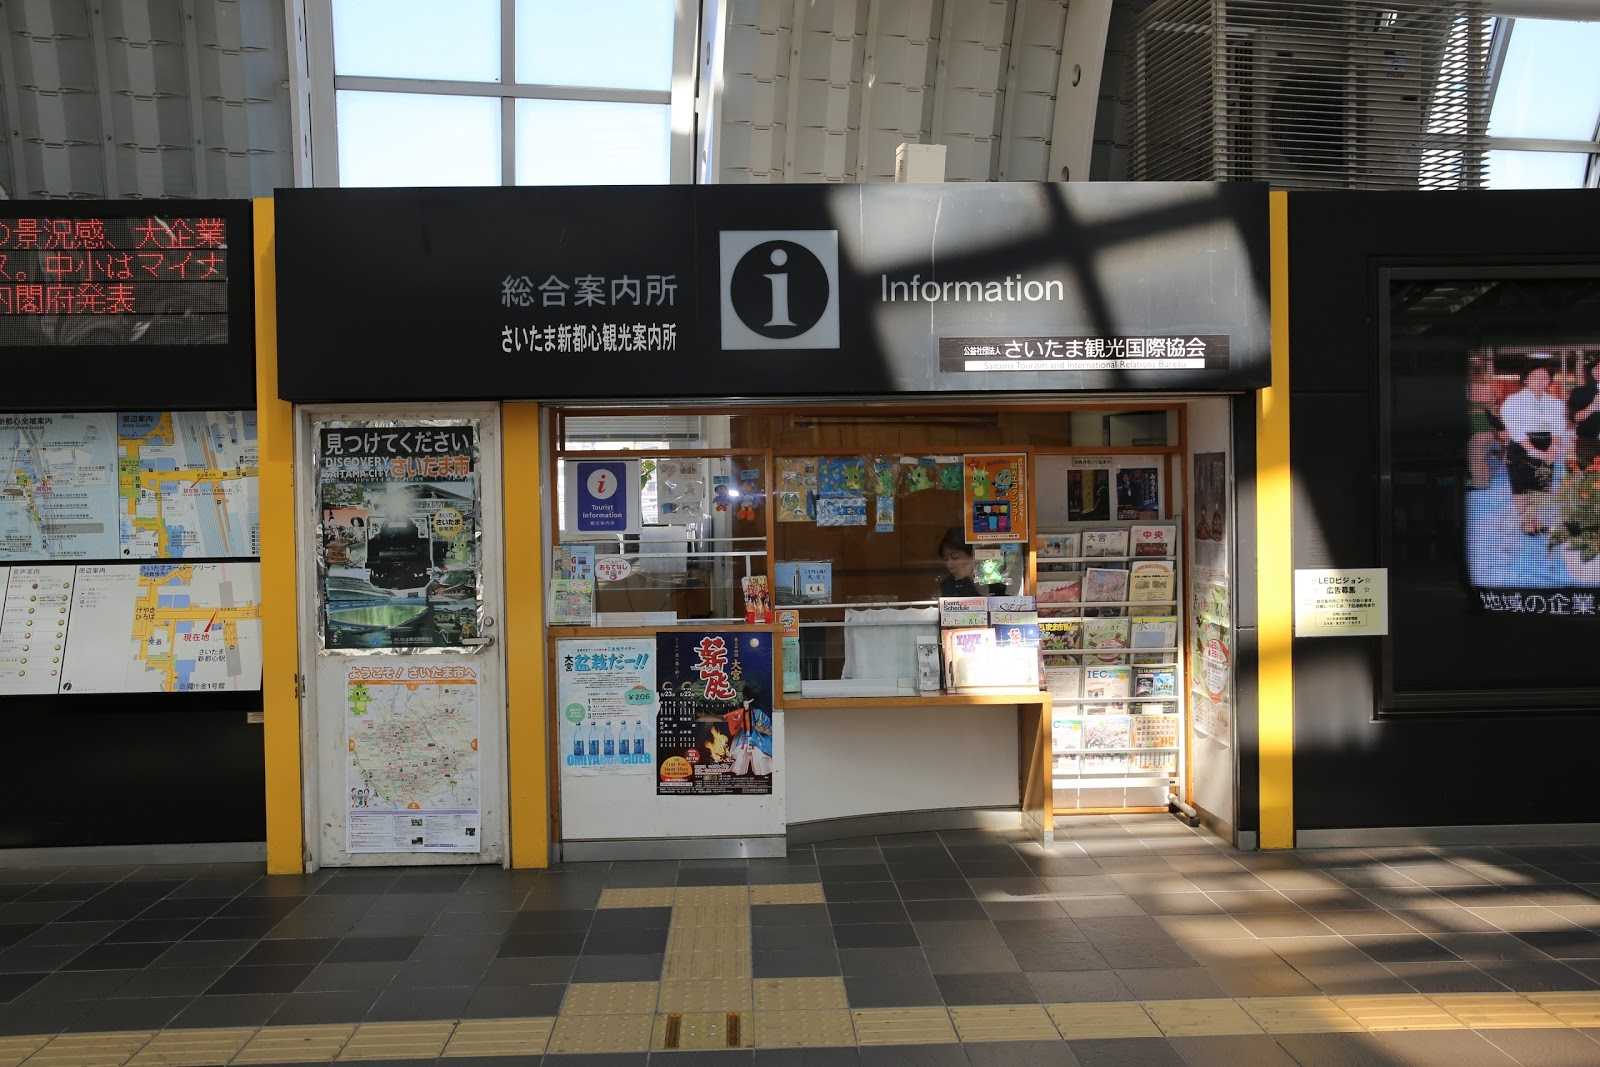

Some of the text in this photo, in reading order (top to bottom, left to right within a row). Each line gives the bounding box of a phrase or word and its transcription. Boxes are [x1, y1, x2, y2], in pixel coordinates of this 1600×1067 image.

[501, 274, 678, 307] 総合案内所
[882, 275, 1065, 303] Information
[501, 324, 678, 353] さいたま新都心観光案内所
[1004, 337, 1206, 359] さいたま観光国際協会
[325, 432, 469, 455] 見つけてください
[325, 456, 390, 468] DISCOVERY
[391, 455, 471, 480] さいたま市
[1143, 530, 1164, 540] 中央
[1480, 593, 1600, 615] 地域の企業
[184, 633, 210, 642] 現在地
[407, 666, 478, 681] さいたま市へ
